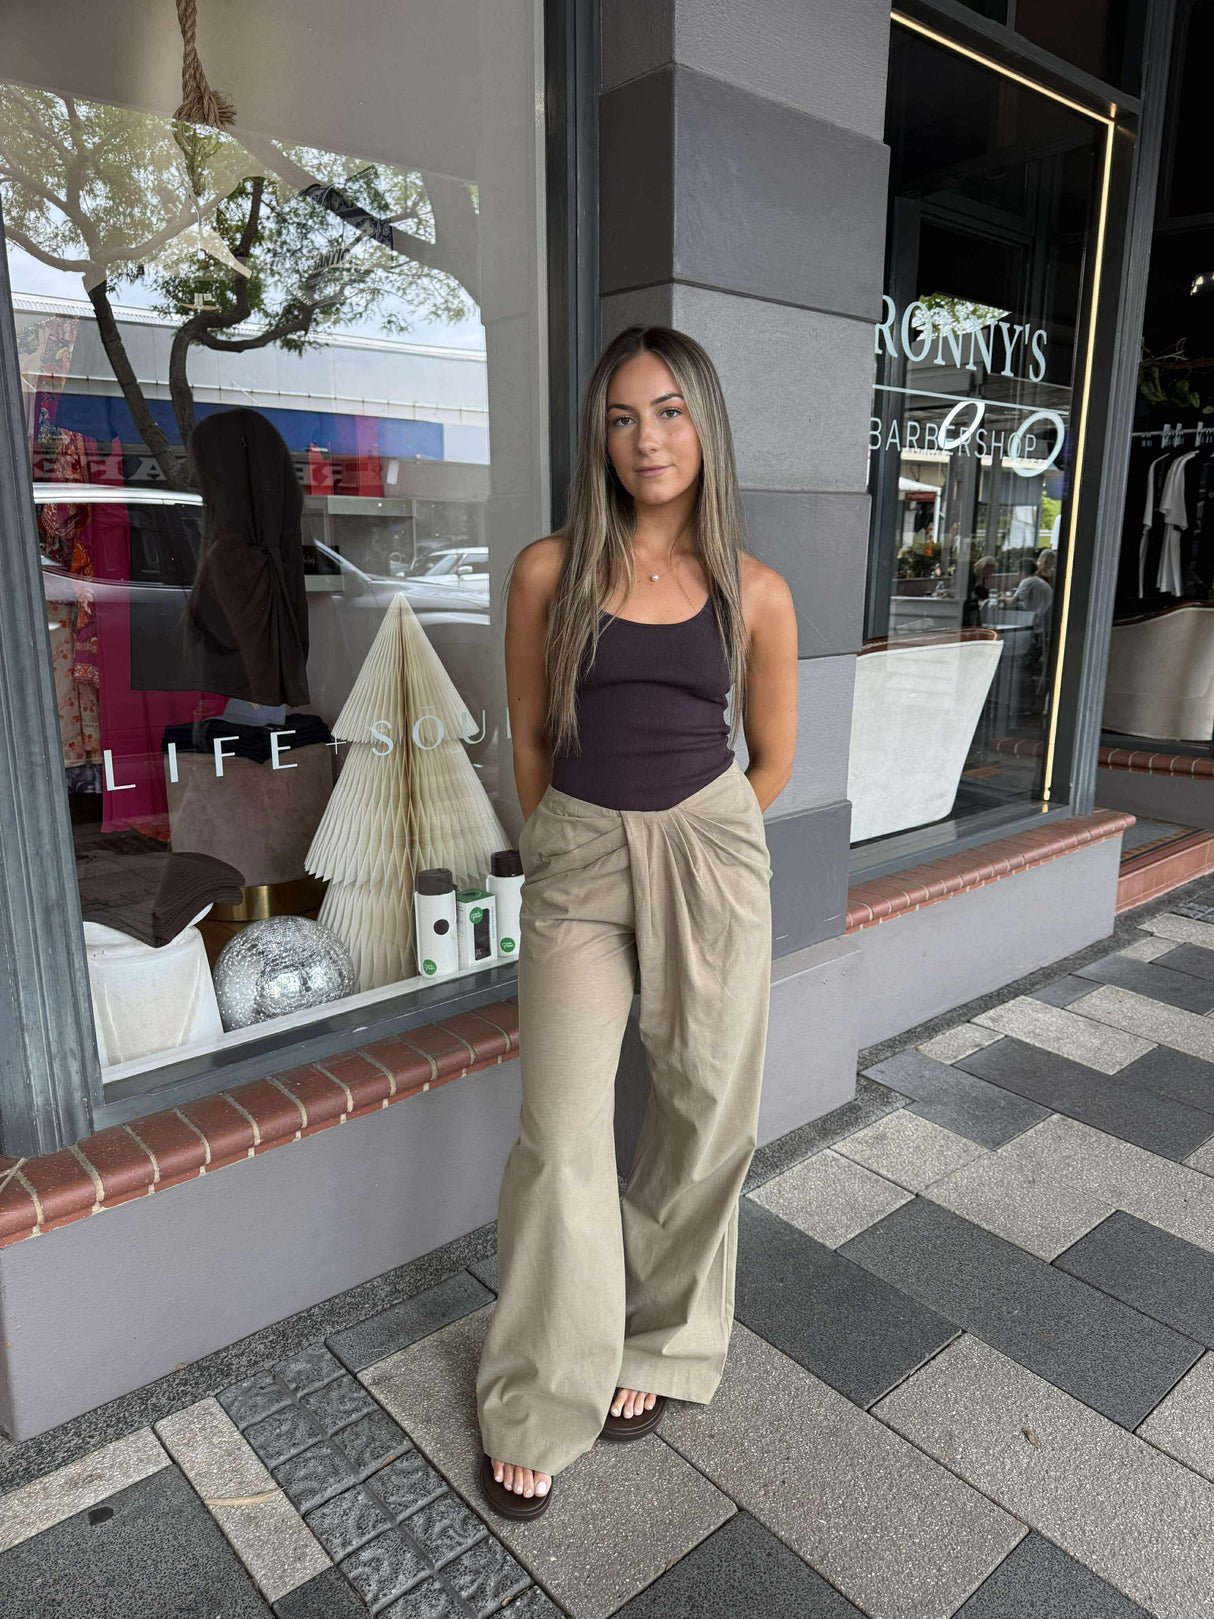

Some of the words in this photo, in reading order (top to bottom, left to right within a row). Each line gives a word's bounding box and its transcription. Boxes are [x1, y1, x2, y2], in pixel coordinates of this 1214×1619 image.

[874, 295, 1047, 382] RONNY'S
[869, 417, 1036, 460] BARBERSHOP
[103, 729, 298, 791] LIFE
